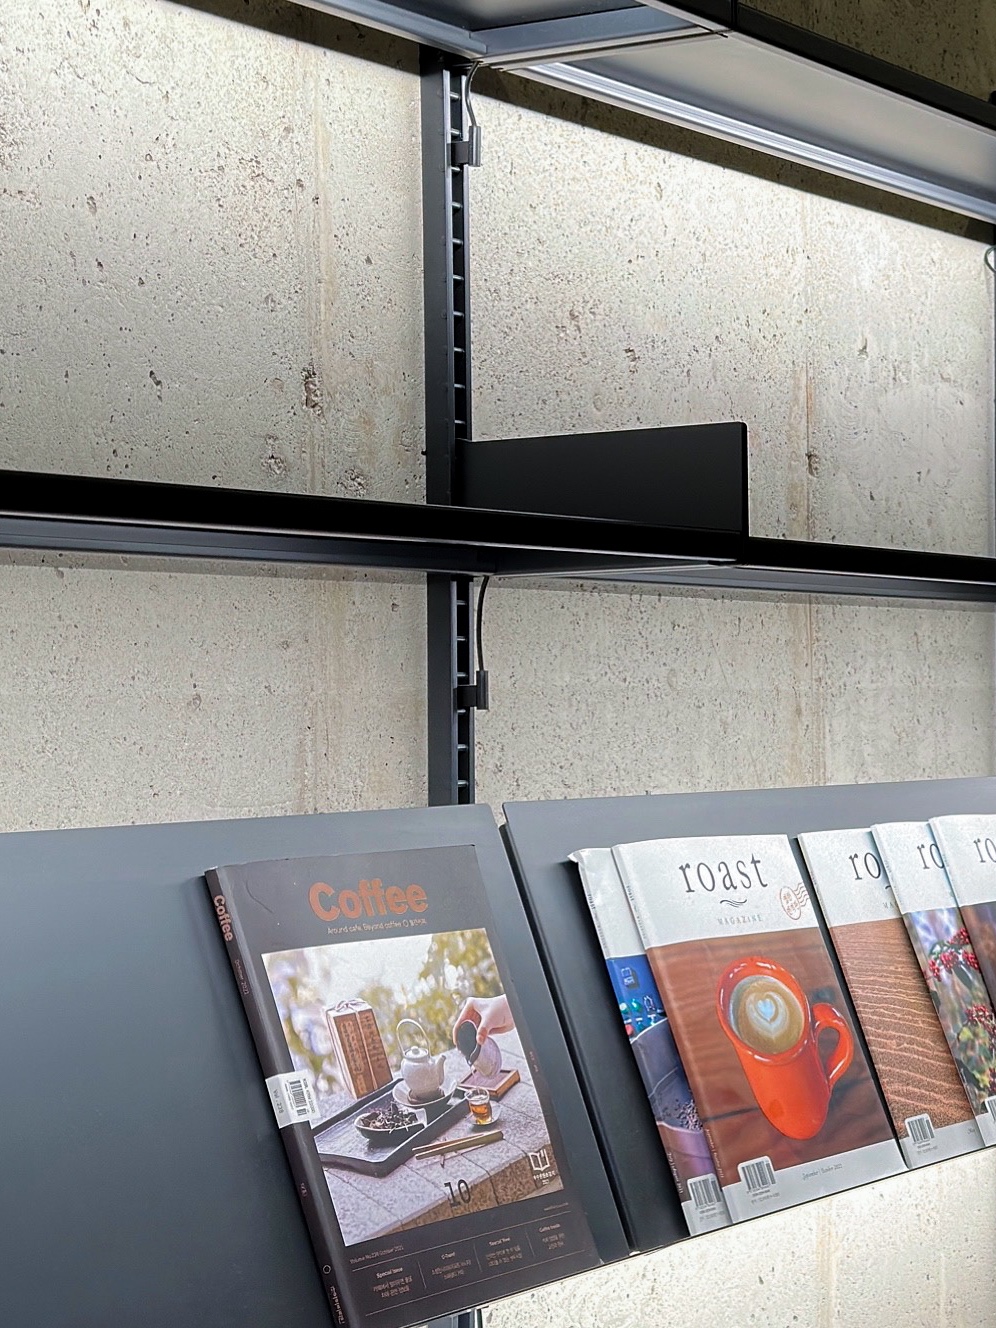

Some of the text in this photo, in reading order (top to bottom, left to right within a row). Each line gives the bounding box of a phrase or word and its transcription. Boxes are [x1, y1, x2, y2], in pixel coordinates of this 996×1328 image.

[678, 853, 768, 893] roast
[213, 894, 234, 942] Coffee
[308, 877, 429, 922] Coffee
[717, 913, 763, 925] MAGAZINE
[444, 1179, 471, 1208] 10
